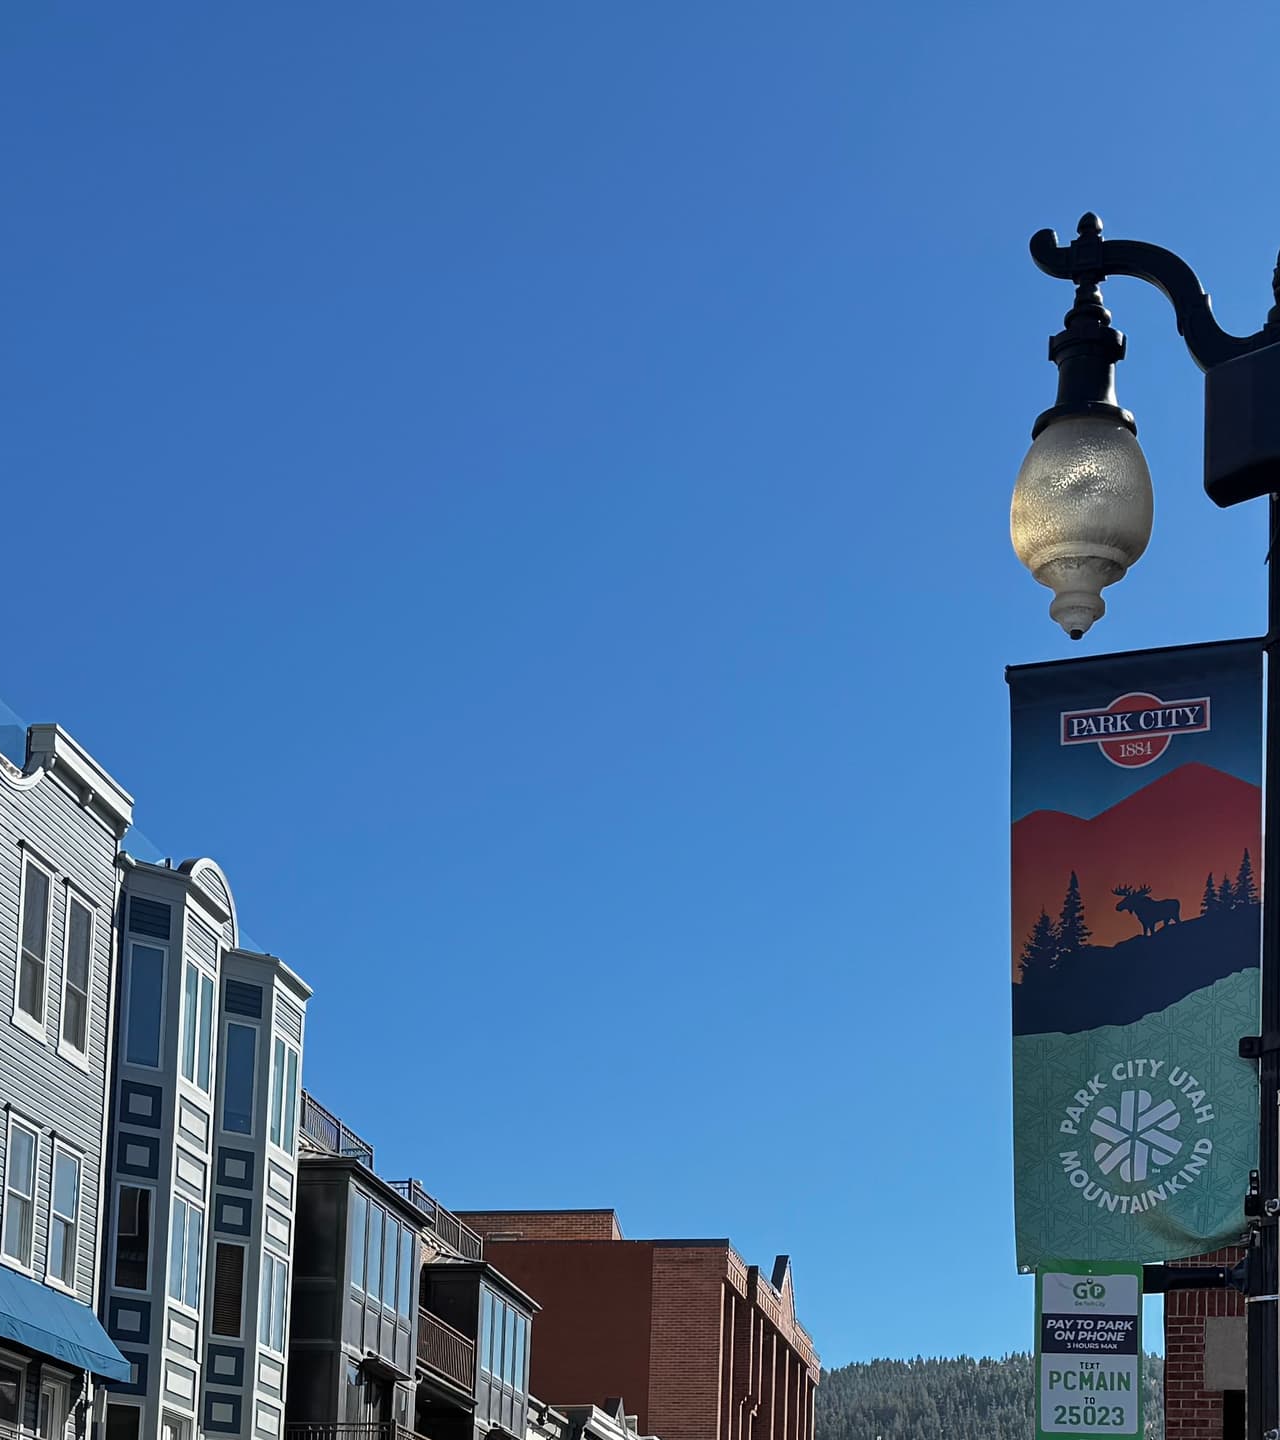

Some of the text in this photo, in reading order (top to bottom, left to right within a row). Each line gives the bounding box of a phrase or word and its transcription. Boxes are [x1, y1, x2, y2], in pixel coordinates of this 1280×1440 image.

[1070, 706, 1201, 737] PARK CITY
[1119, 742, 1152, 758] 1884
[1060, 1059, 1215, 1134] PARK CITY UTAH
[1059, 1138, 1213, 1214] MOUNTAINKIND
[1046, 1319, 1135, 1331] PAY TO PARK
[1054, 1330, 1126, 1341] ON PHONE
[1080, 1361, 1100, 1370] TEXT
[1048, 1370, 1131, 1392] PCMAIN
[1085, 1397, 1096, 1405] TO
[1054, 1405, 1125, 1426] 25023
